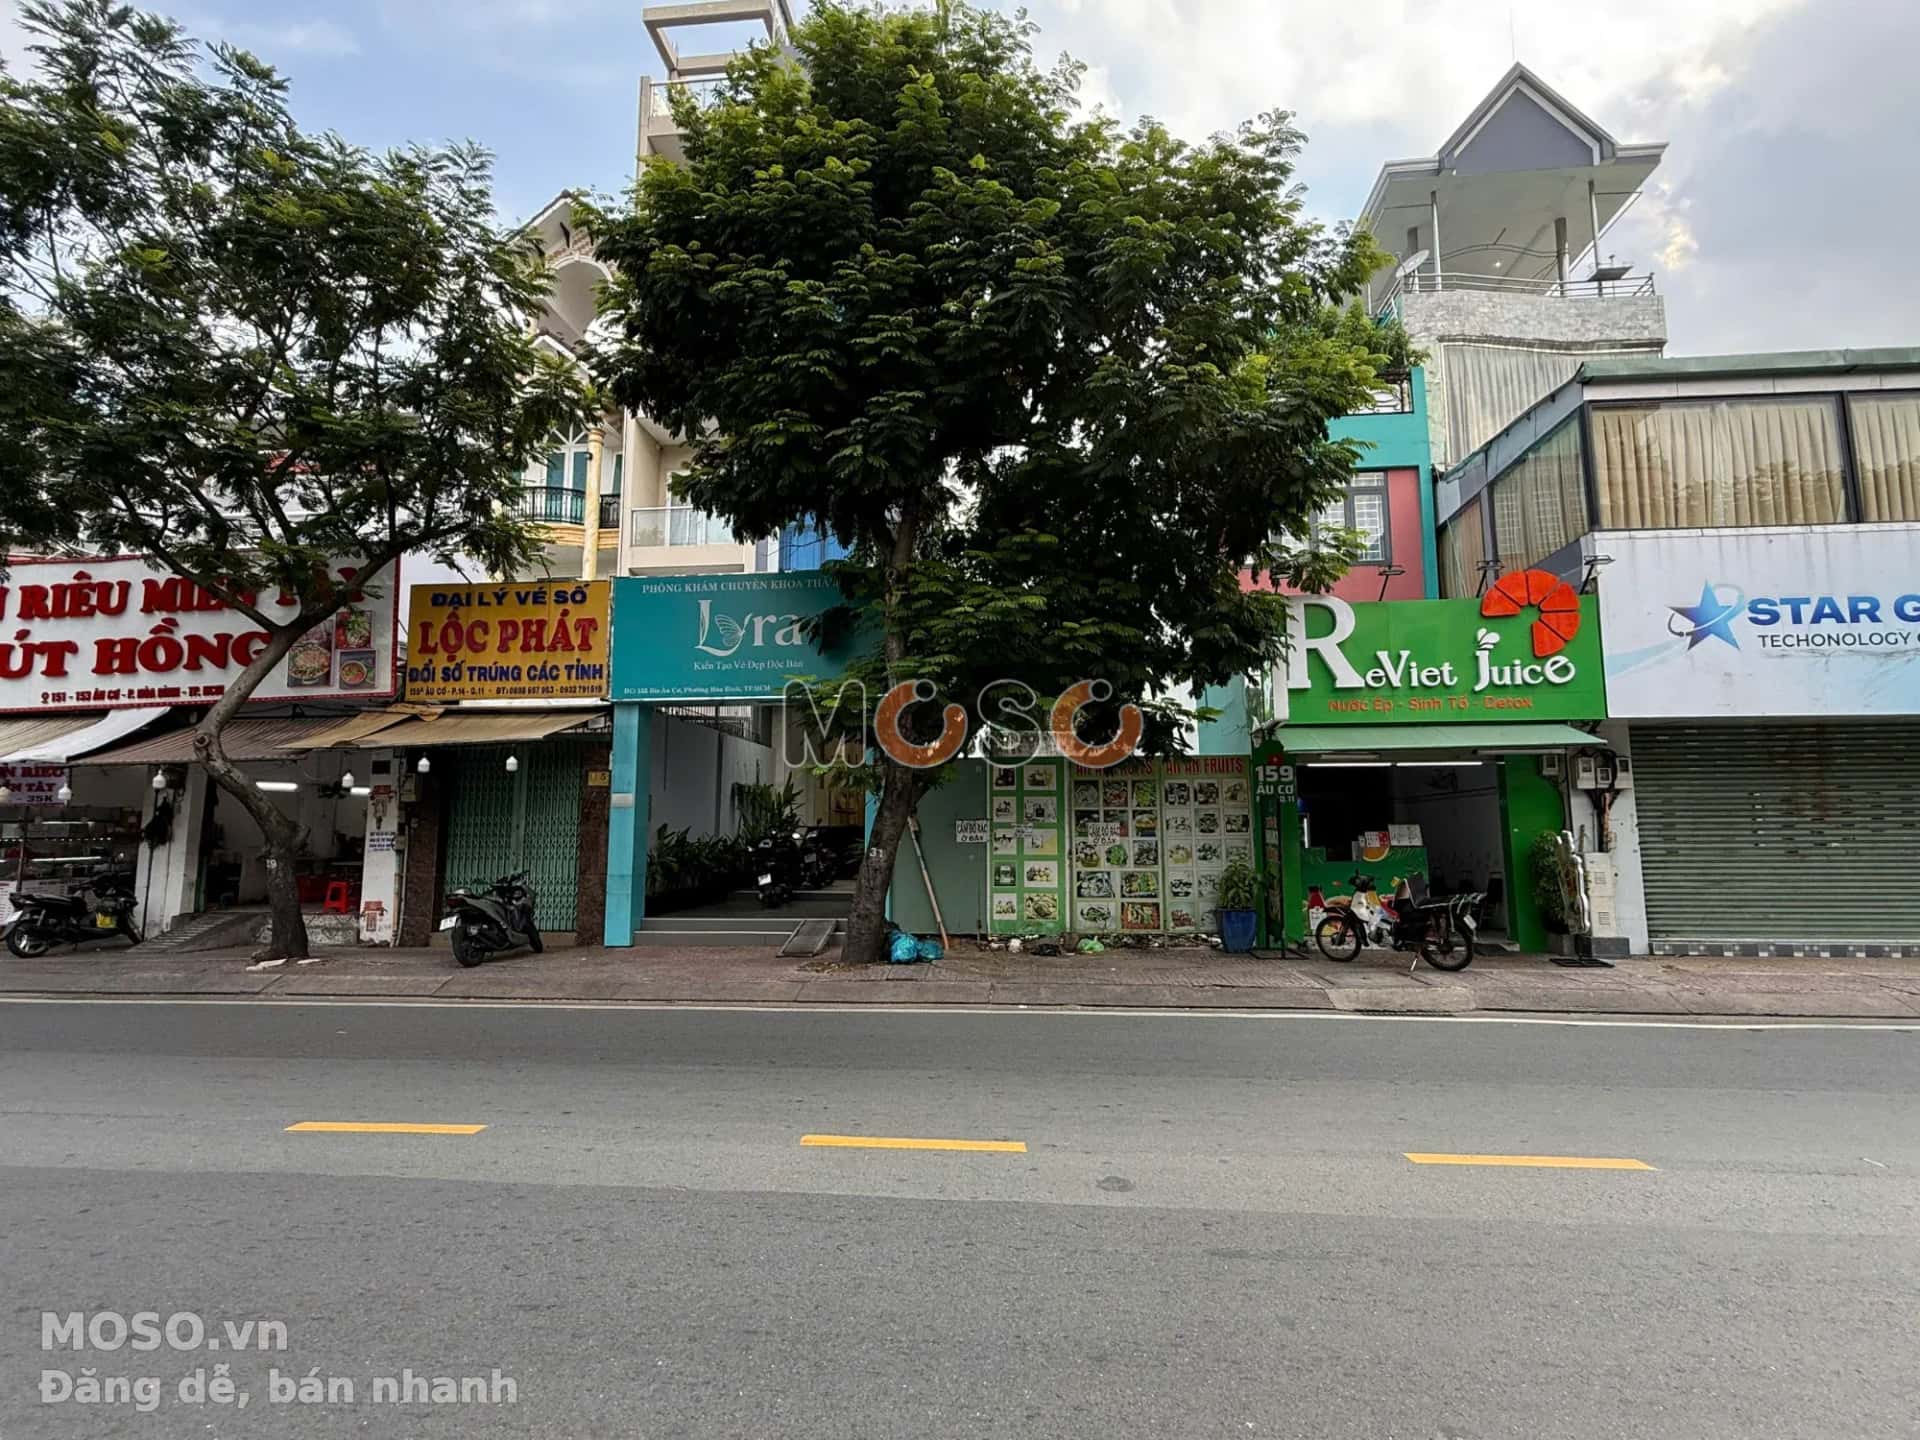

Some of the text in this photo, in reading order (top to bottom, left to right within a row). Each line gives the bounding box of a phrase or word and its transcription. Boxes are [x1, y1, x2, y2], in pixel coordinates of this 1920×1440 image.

[17, 570, 131, 620] RIÊU
[478, 587, 509, 606] LÝ
[515, 587, 547, 605] VÉ
[553, 584, 590, 604] SỐ
[642, 582, 681, 593] PHÒNG
[685, 580, 717, 592] KHÁM
[720, 578, 768, 591] CHUYÊN
[1747, 596, 1882, 625] STAR
[91, 618, 273, 675] HỒNG
[418, 609, 598, 662] LỘC PHÁT
[1758, 631, 1911, 649] TECHONOLOGY
[441, 660, 465, 681] SỐ
[467, 661, 521, 682] TRÚNG
[527, 661, 560, 681] CÁC
[565, 658, 603, 681] TỈNH
[1205, 757, 1243, 773] FRUITS
[1255, 765, 1294, 782] 159
[1256, 783, 1274, 795] ÂU
